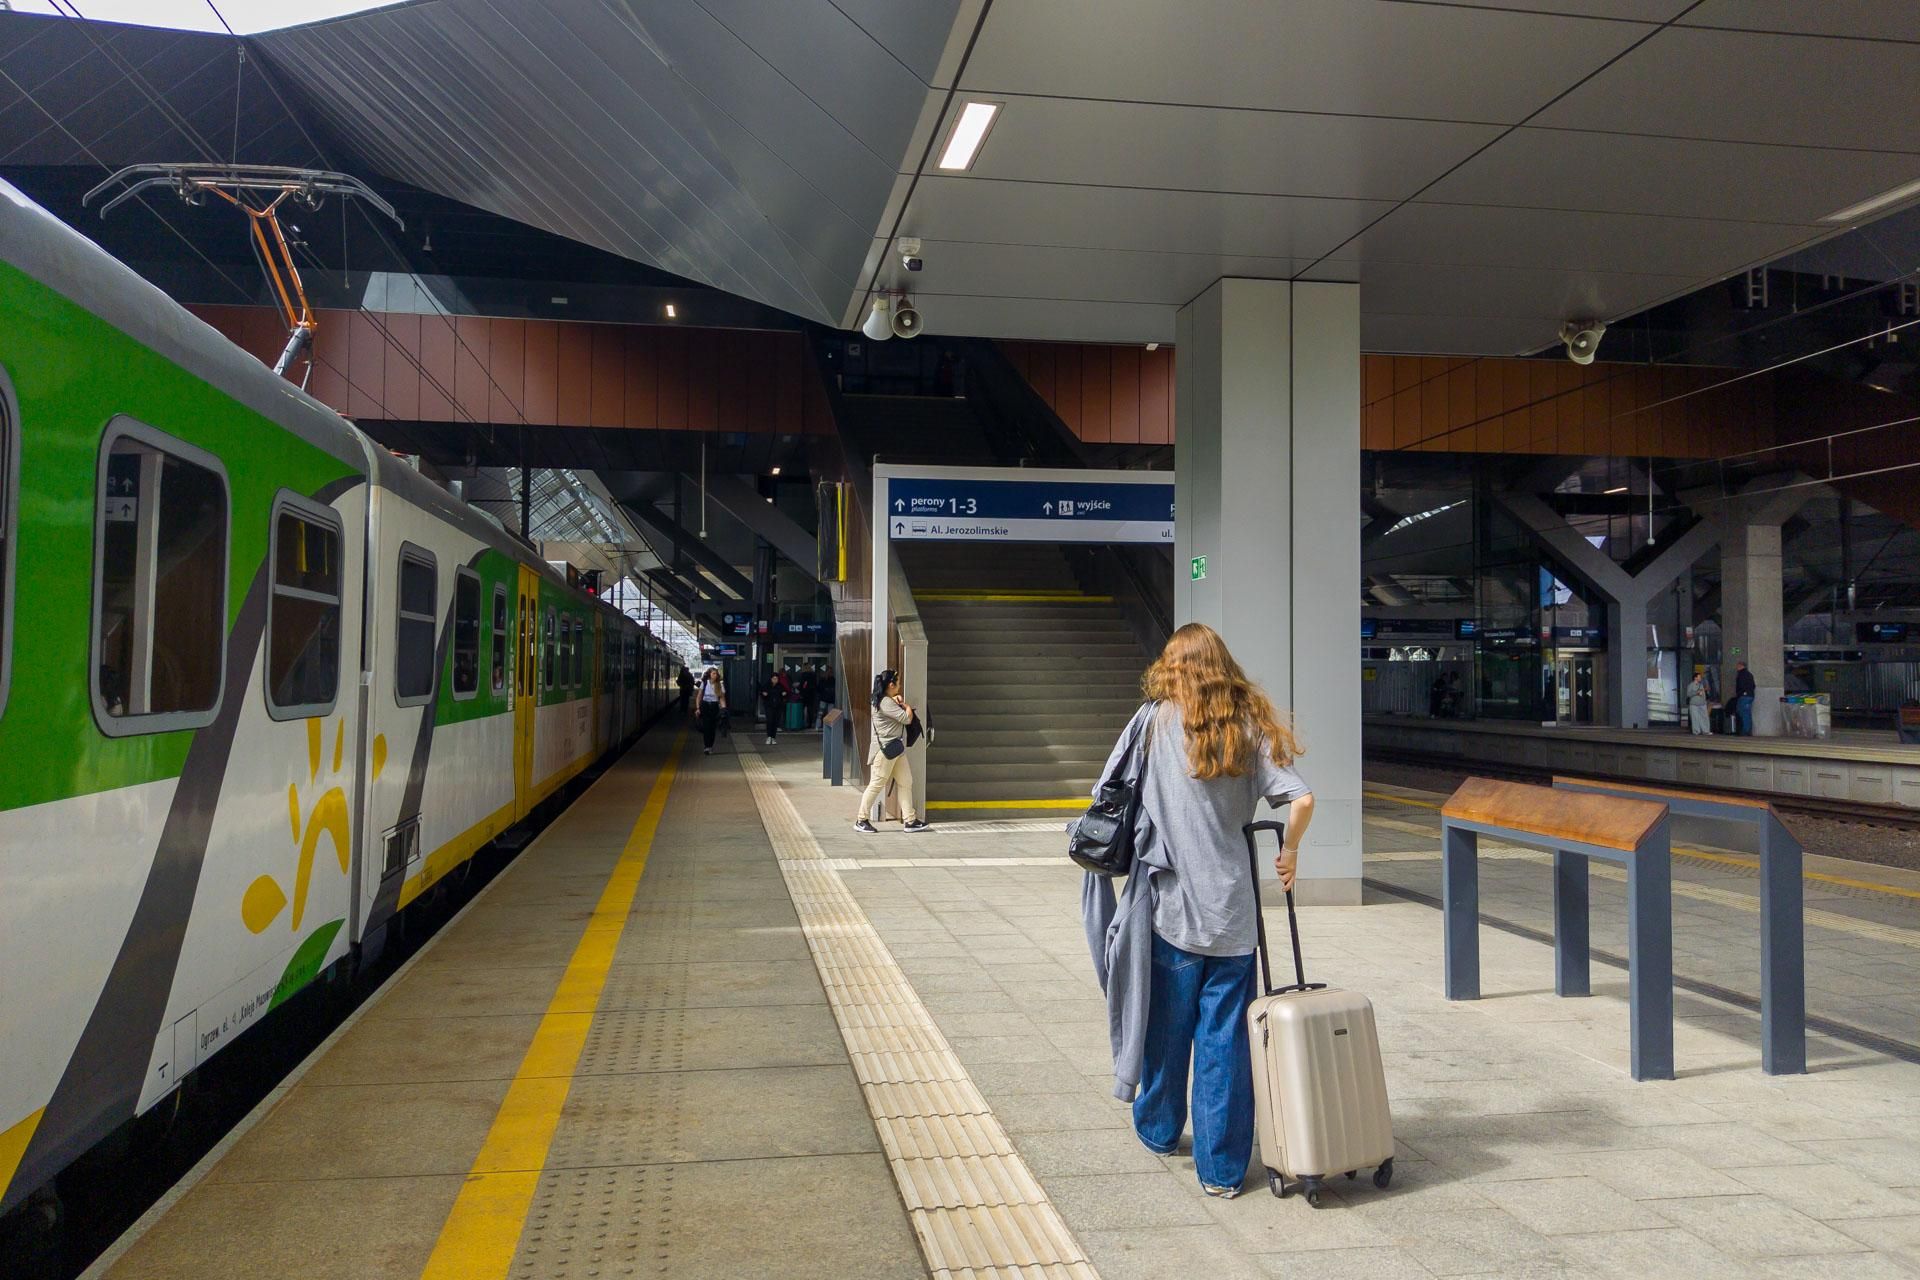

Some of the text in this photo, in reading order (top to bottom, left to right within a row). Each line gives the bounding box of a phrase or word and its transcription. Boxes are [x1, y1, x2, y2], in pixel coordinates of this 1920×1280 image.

[911, 497, 977, 514] perony 1-3
[1077, 500, 1111, 512] wyjście
[931, 525, 1009, 536] Al. Jerozolimskie
[1161, 529, 1173, 538] ul.
